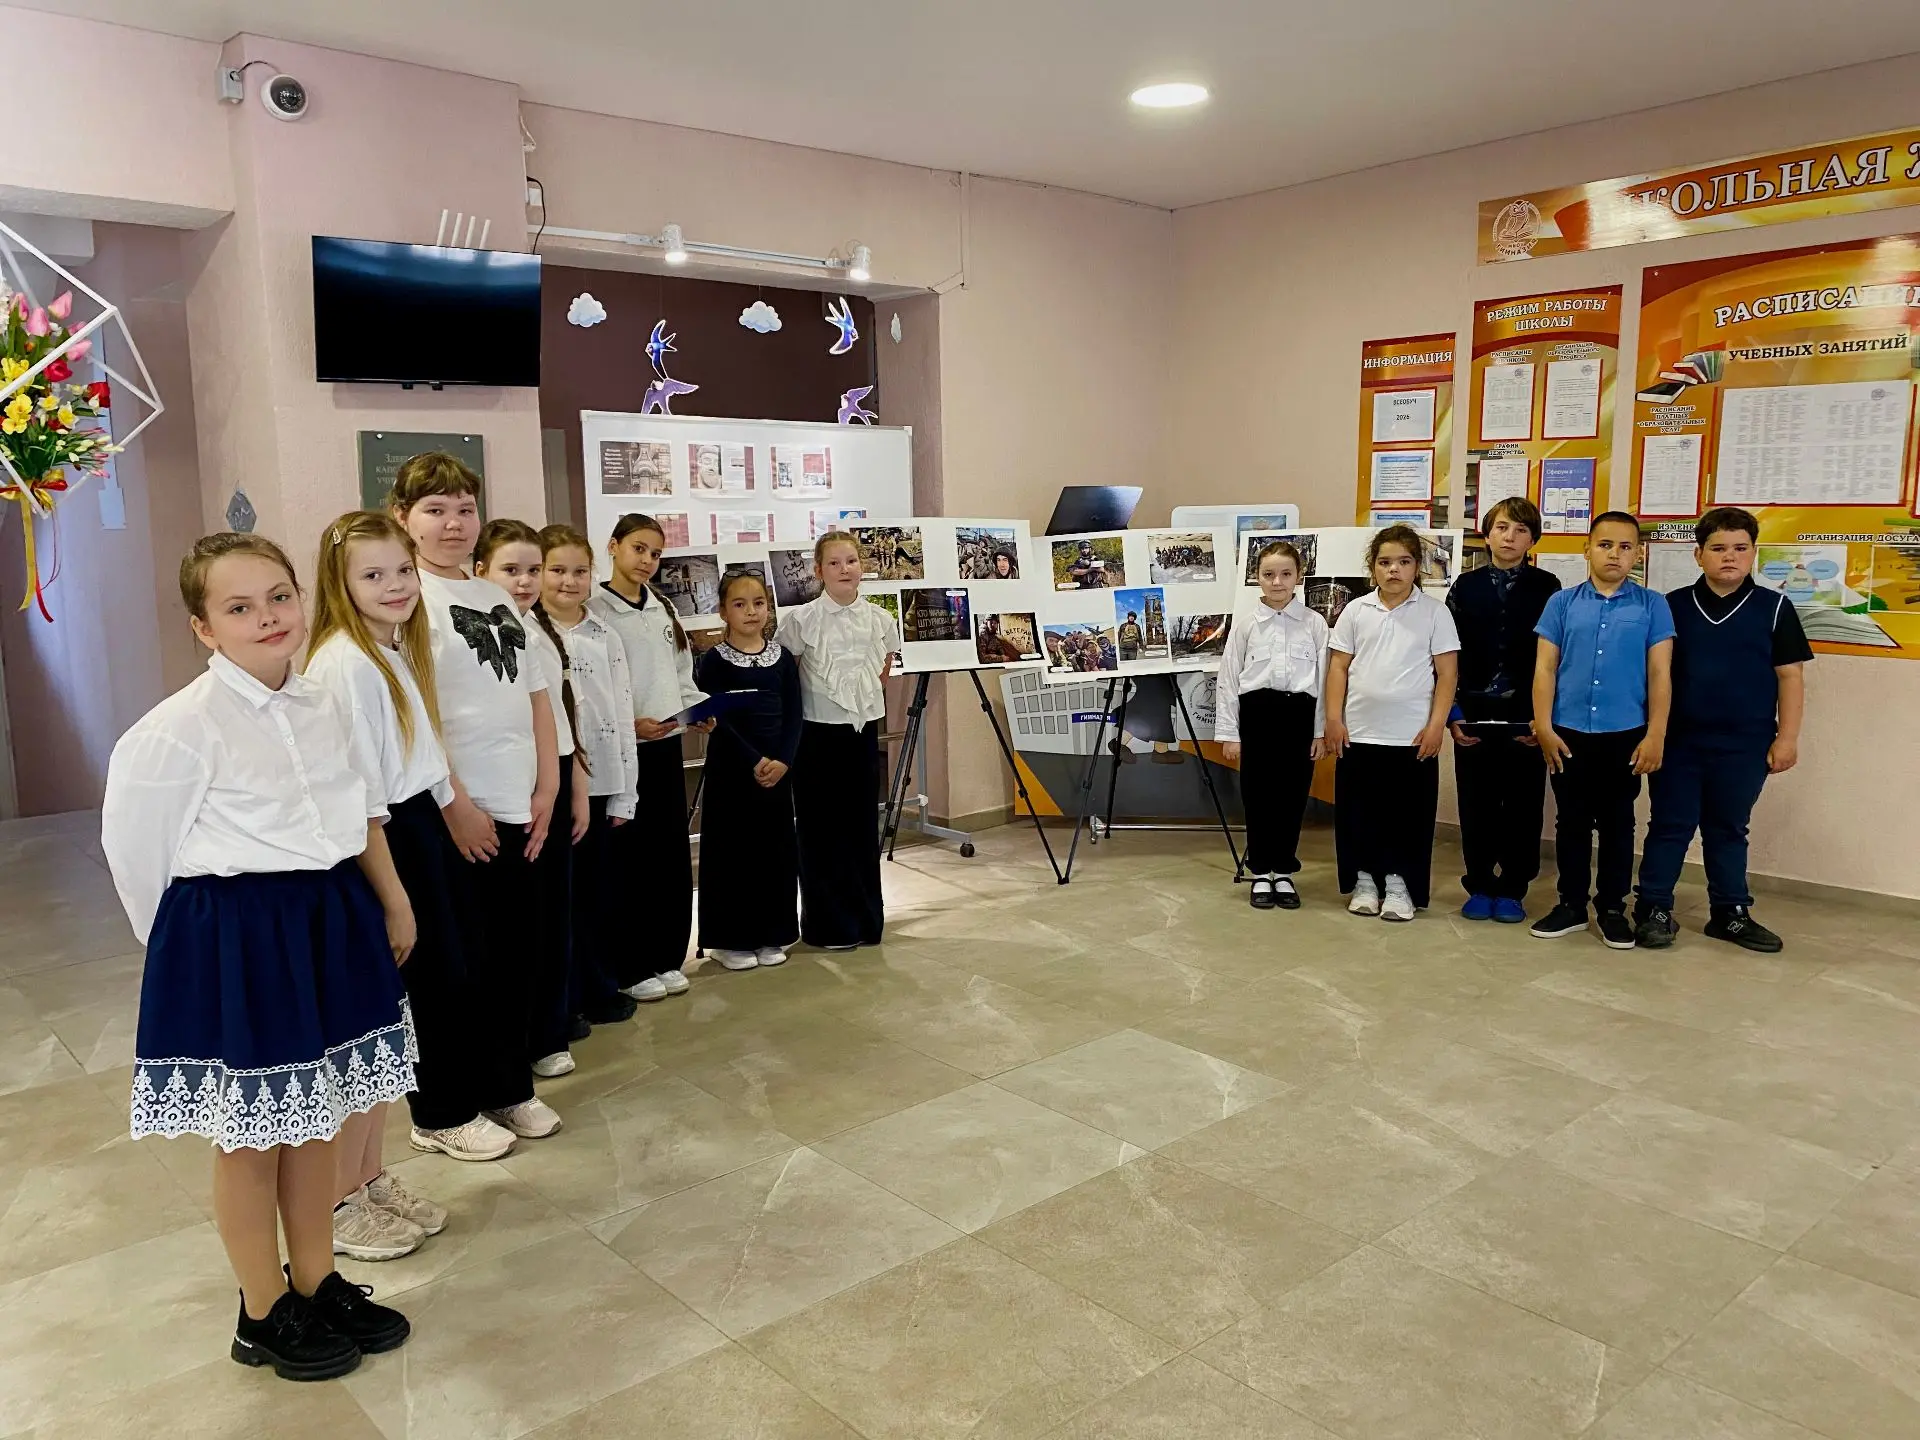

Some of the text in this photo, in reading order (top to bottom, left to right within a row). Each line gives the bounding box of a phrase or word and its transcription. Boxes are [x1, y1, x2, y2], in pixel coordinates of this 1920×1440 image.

[1624, 146, 1892, 217] КОЛЬНАЯ
[1487, 299, 1608, 322] РЕЖИМ РАБОТЫ
[1715, 283, 1920, 328] РАСПИСАЕ
[1515, 315, 1574, 331] ШКОЛЫ
[1729, 333, 1908, 361] УЧЕБНЫХ ЗАНЯТИЙ
[1363, 351, 1453, 368] ИНФОРМАЦИЯ
[1797, 534, 1920, 542] ОРГАНИЗАЦИЯ ДОСУГА
